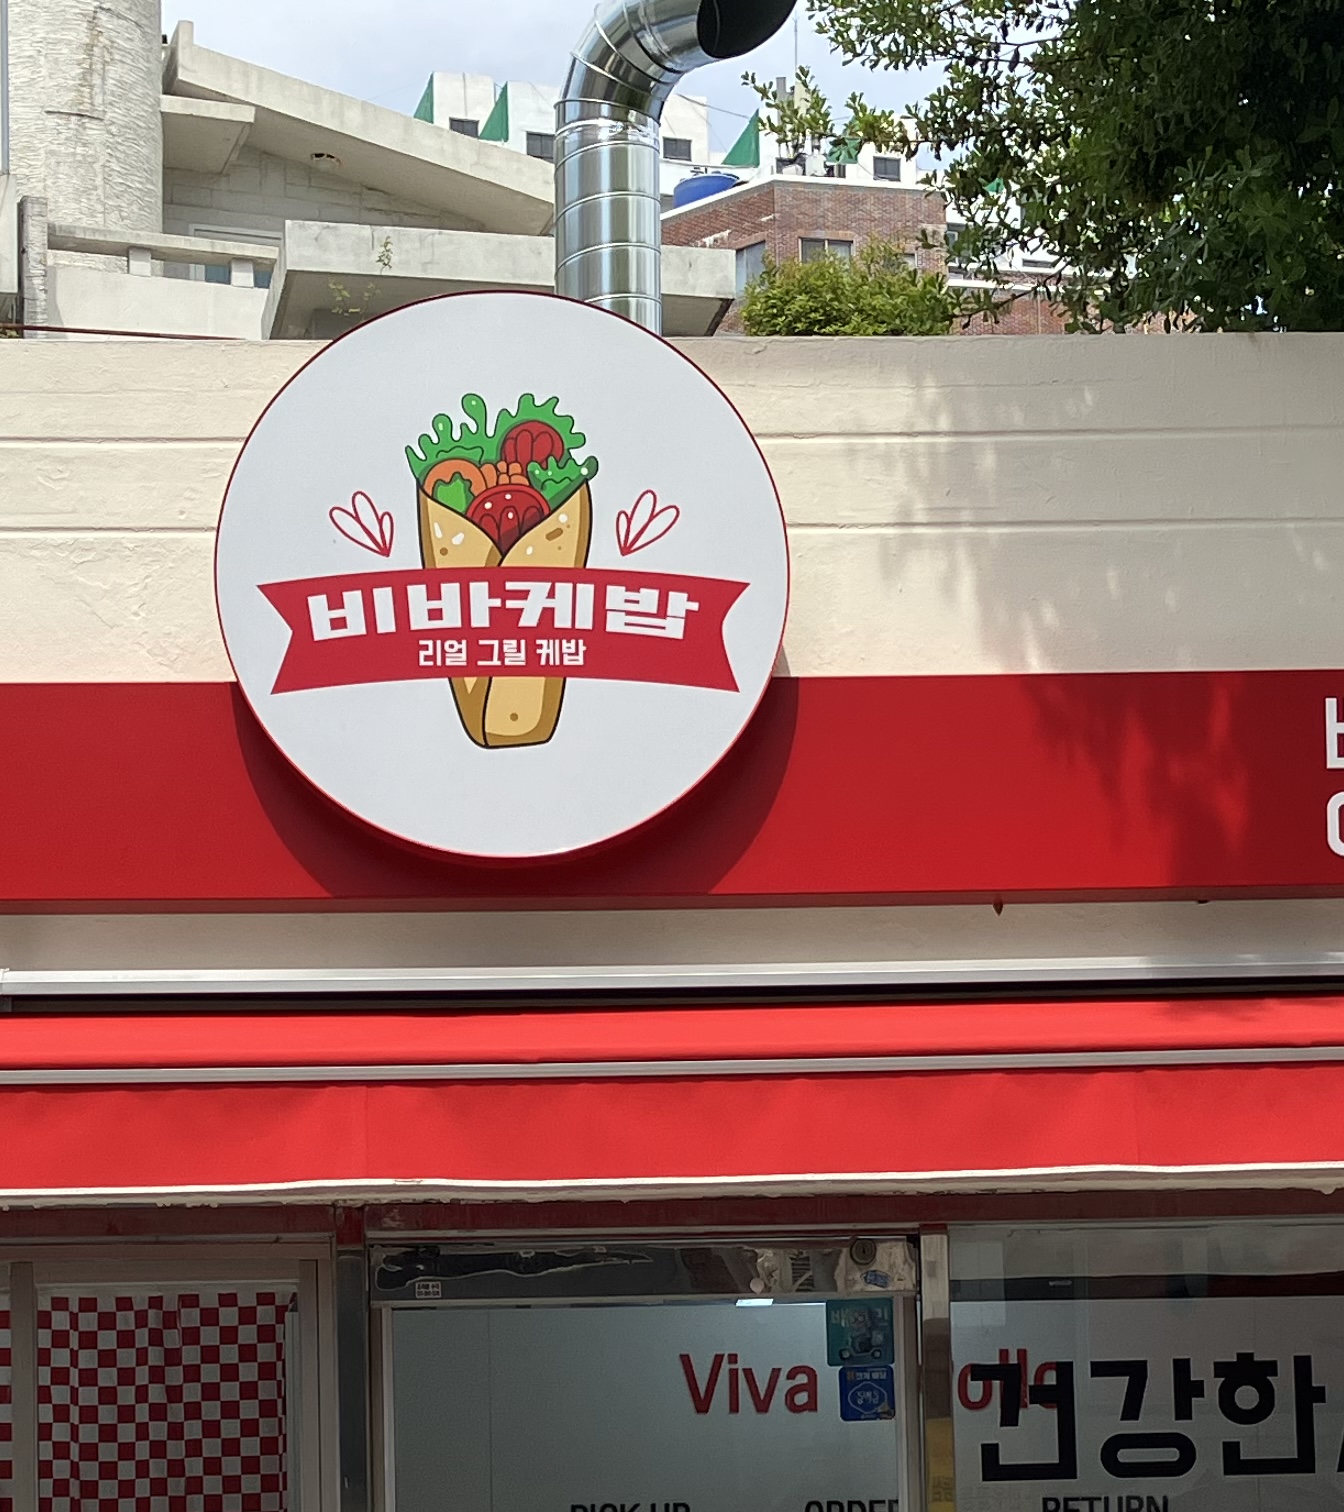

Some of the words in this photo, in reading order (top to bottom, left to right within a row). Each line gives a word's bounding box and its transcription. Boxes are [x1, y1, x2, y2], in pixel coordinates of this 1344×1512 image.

[307, 581, 699, 641] 비바케밥
[418, 639, 467, 667] 리얼
[477, 639, 526, 666] 그릴
[536, 638, 586, 665] 케밥
[680, 1353, 819, 1414] Viva
